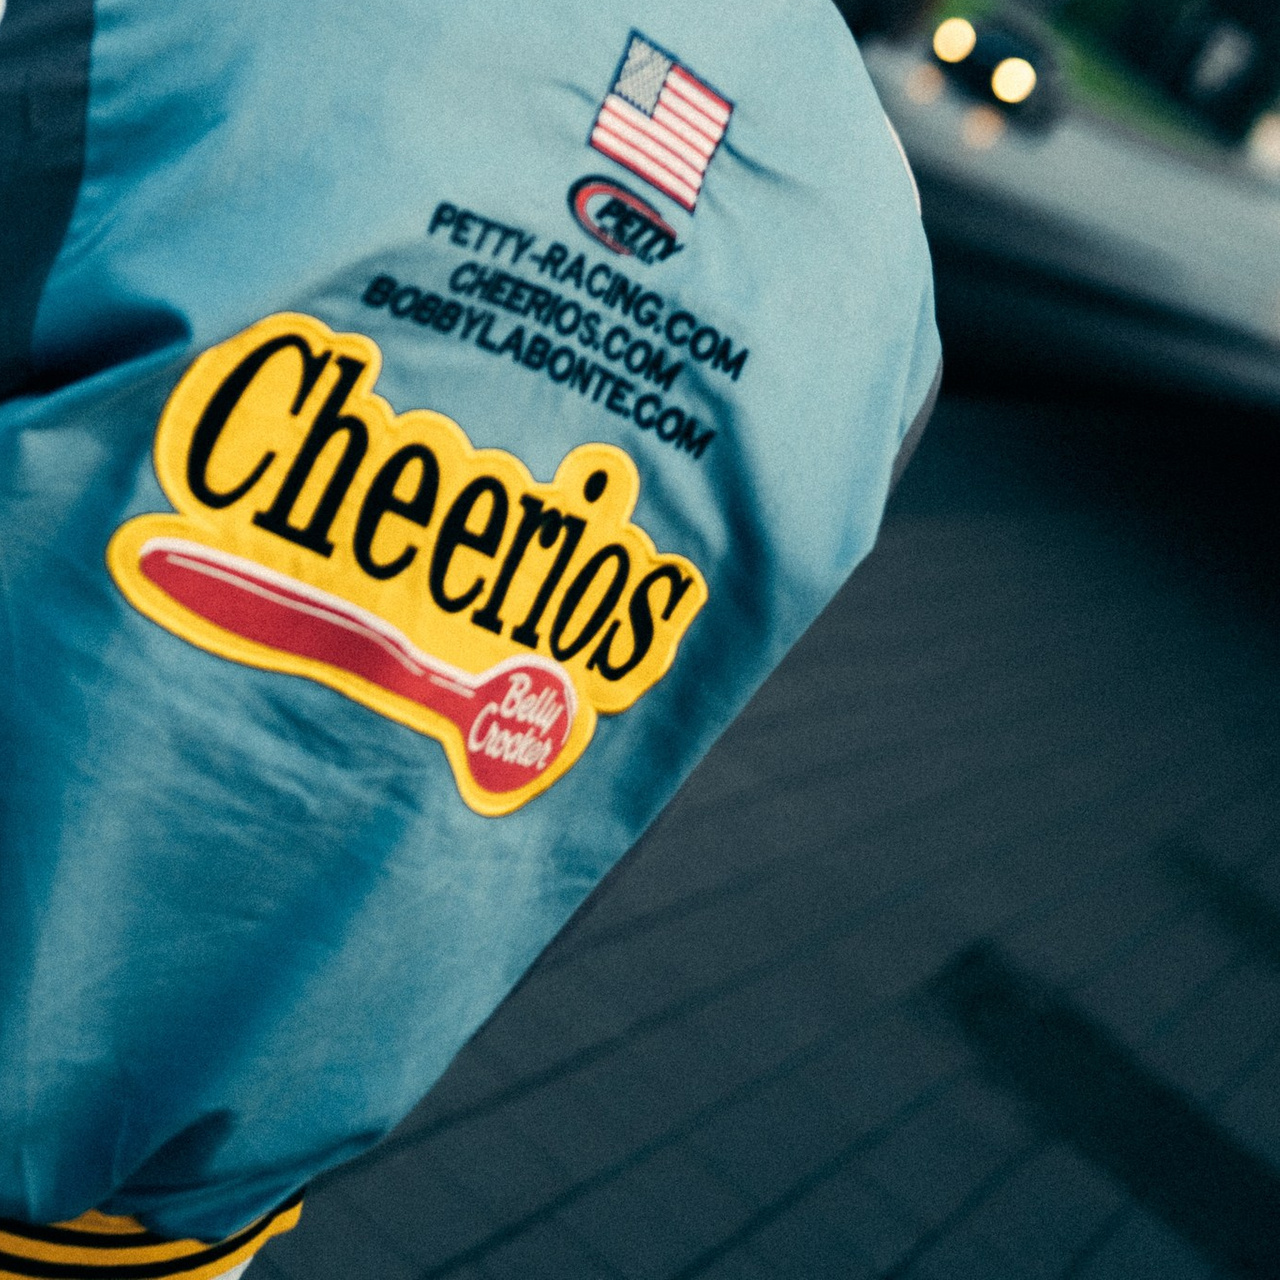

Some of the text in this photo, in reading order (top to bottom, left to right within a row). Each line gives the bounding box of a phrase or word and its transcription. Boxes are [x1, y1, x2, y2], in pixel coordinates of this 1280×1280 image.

[361, 274, 717, 460] BOBBYLABONTE.COM
[428, 201, 749, 381] PETTY-RACING.COM
[449, 261, 683, 393] CHEERIOS.COM
[186, 333, 694, 682] Cheerios
